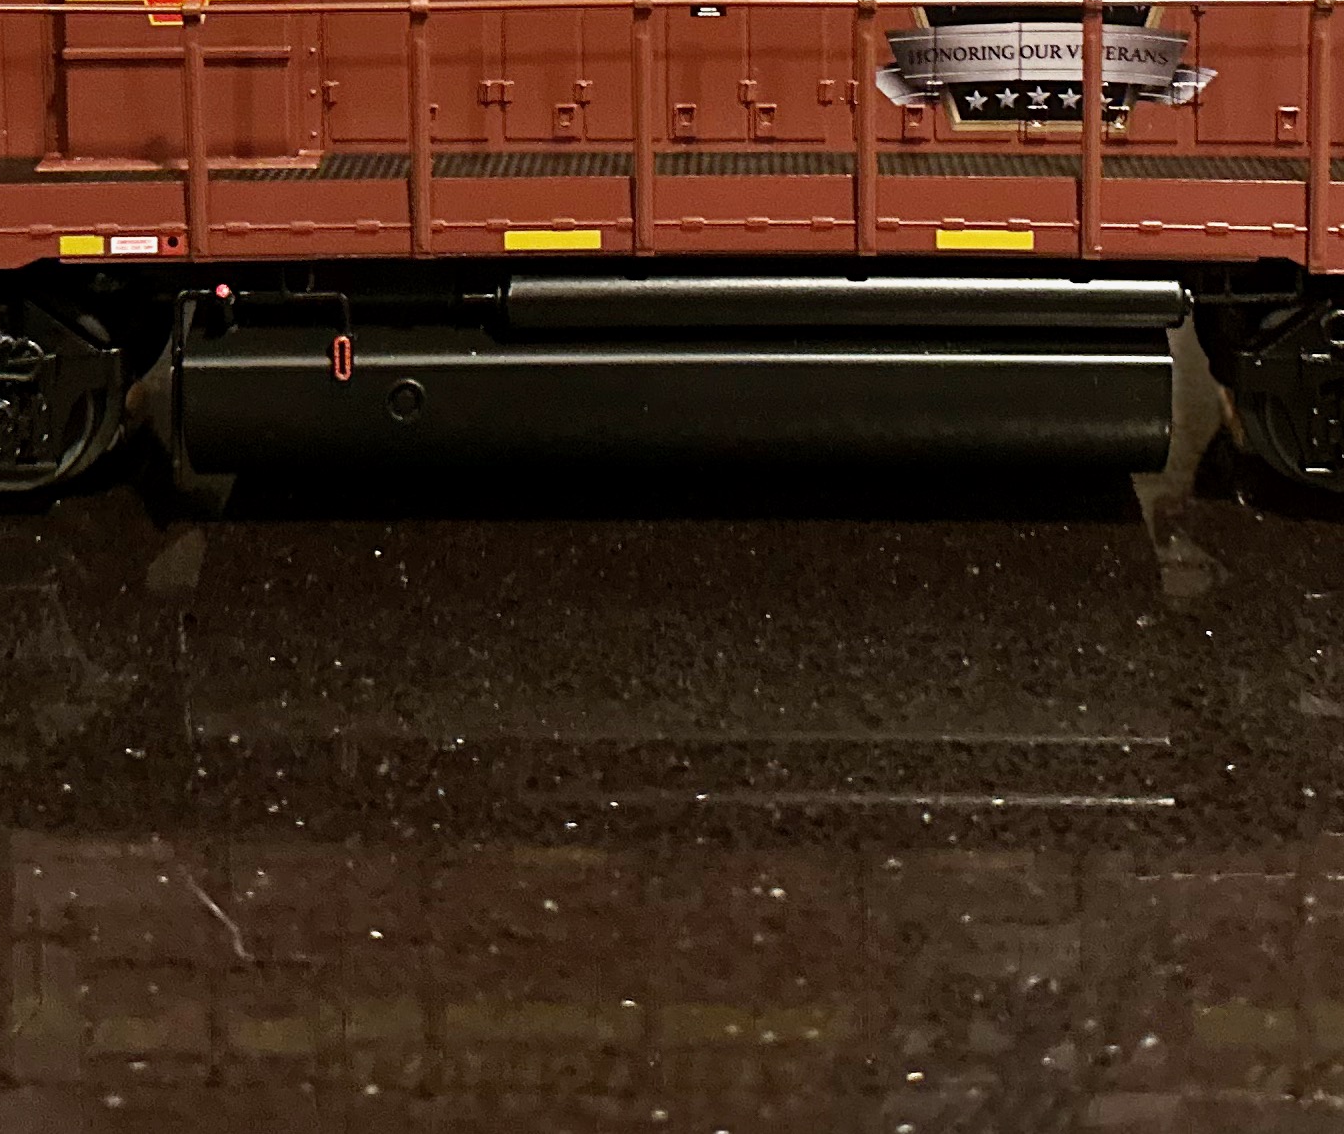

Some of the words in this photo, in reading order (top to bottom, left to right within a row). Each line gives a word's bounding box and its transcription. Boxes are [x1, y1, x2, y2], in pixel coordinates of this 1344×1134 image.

[907, 45, 1016, 66] HONORING
[1019, 44, 1063, 60] OUR
[1066, 44, 1169, 66] VERANS
